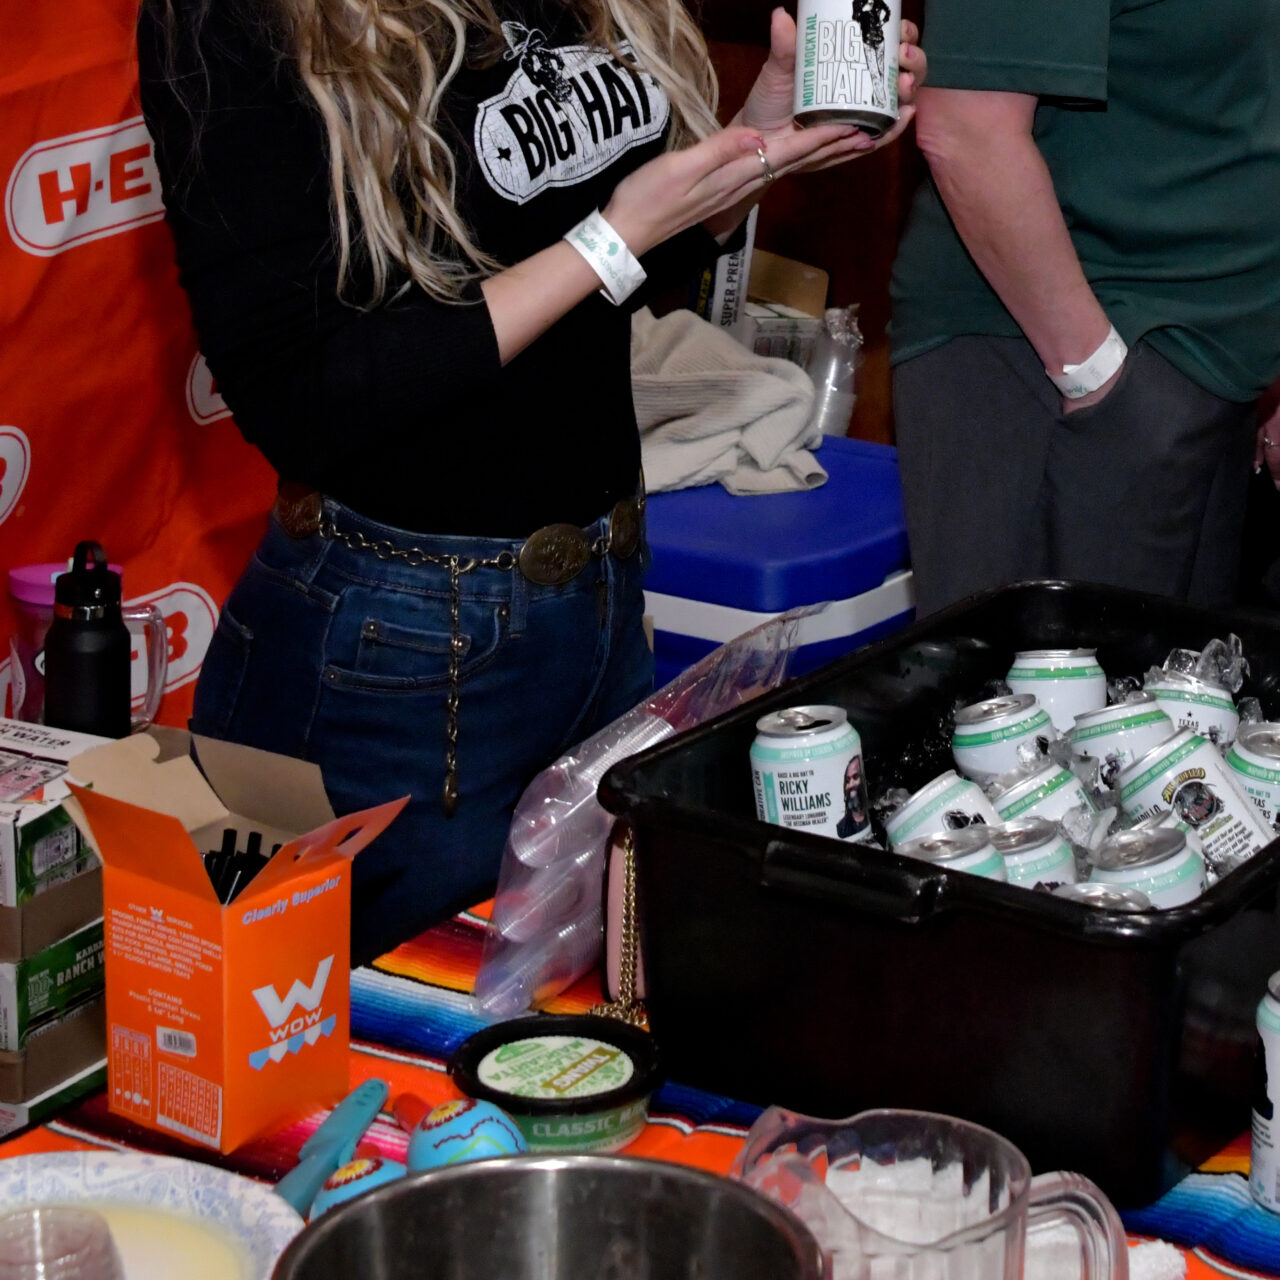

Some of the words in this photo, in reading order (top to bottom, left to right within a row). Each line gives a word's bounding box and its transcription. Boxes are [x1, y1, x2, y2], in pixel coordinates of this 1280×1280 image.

[804, 13, 817, 67] MOCKTAIL
[818, 20, 865, 63] BIG
[802, 70, 815, 106] NOJITO
[816, 61, 869, 105] HAT
[500, 89, 577, 180] BIG
[1179, 719, 1199, 728] TEXAS
[778, 779, 809, 796] RICKY
[780, 792, 832, 812] WILLIAMS
[242, 897, 289, 925] Clearly
[292, 876, 341, 907] Superior
[57, 956, 95, 987] RANCH
[269, 1008, 322, 1042] WOW
[552, 1053, 610, 1090] TWANG
[532, 1119, 610, 1137] CLASSIC
